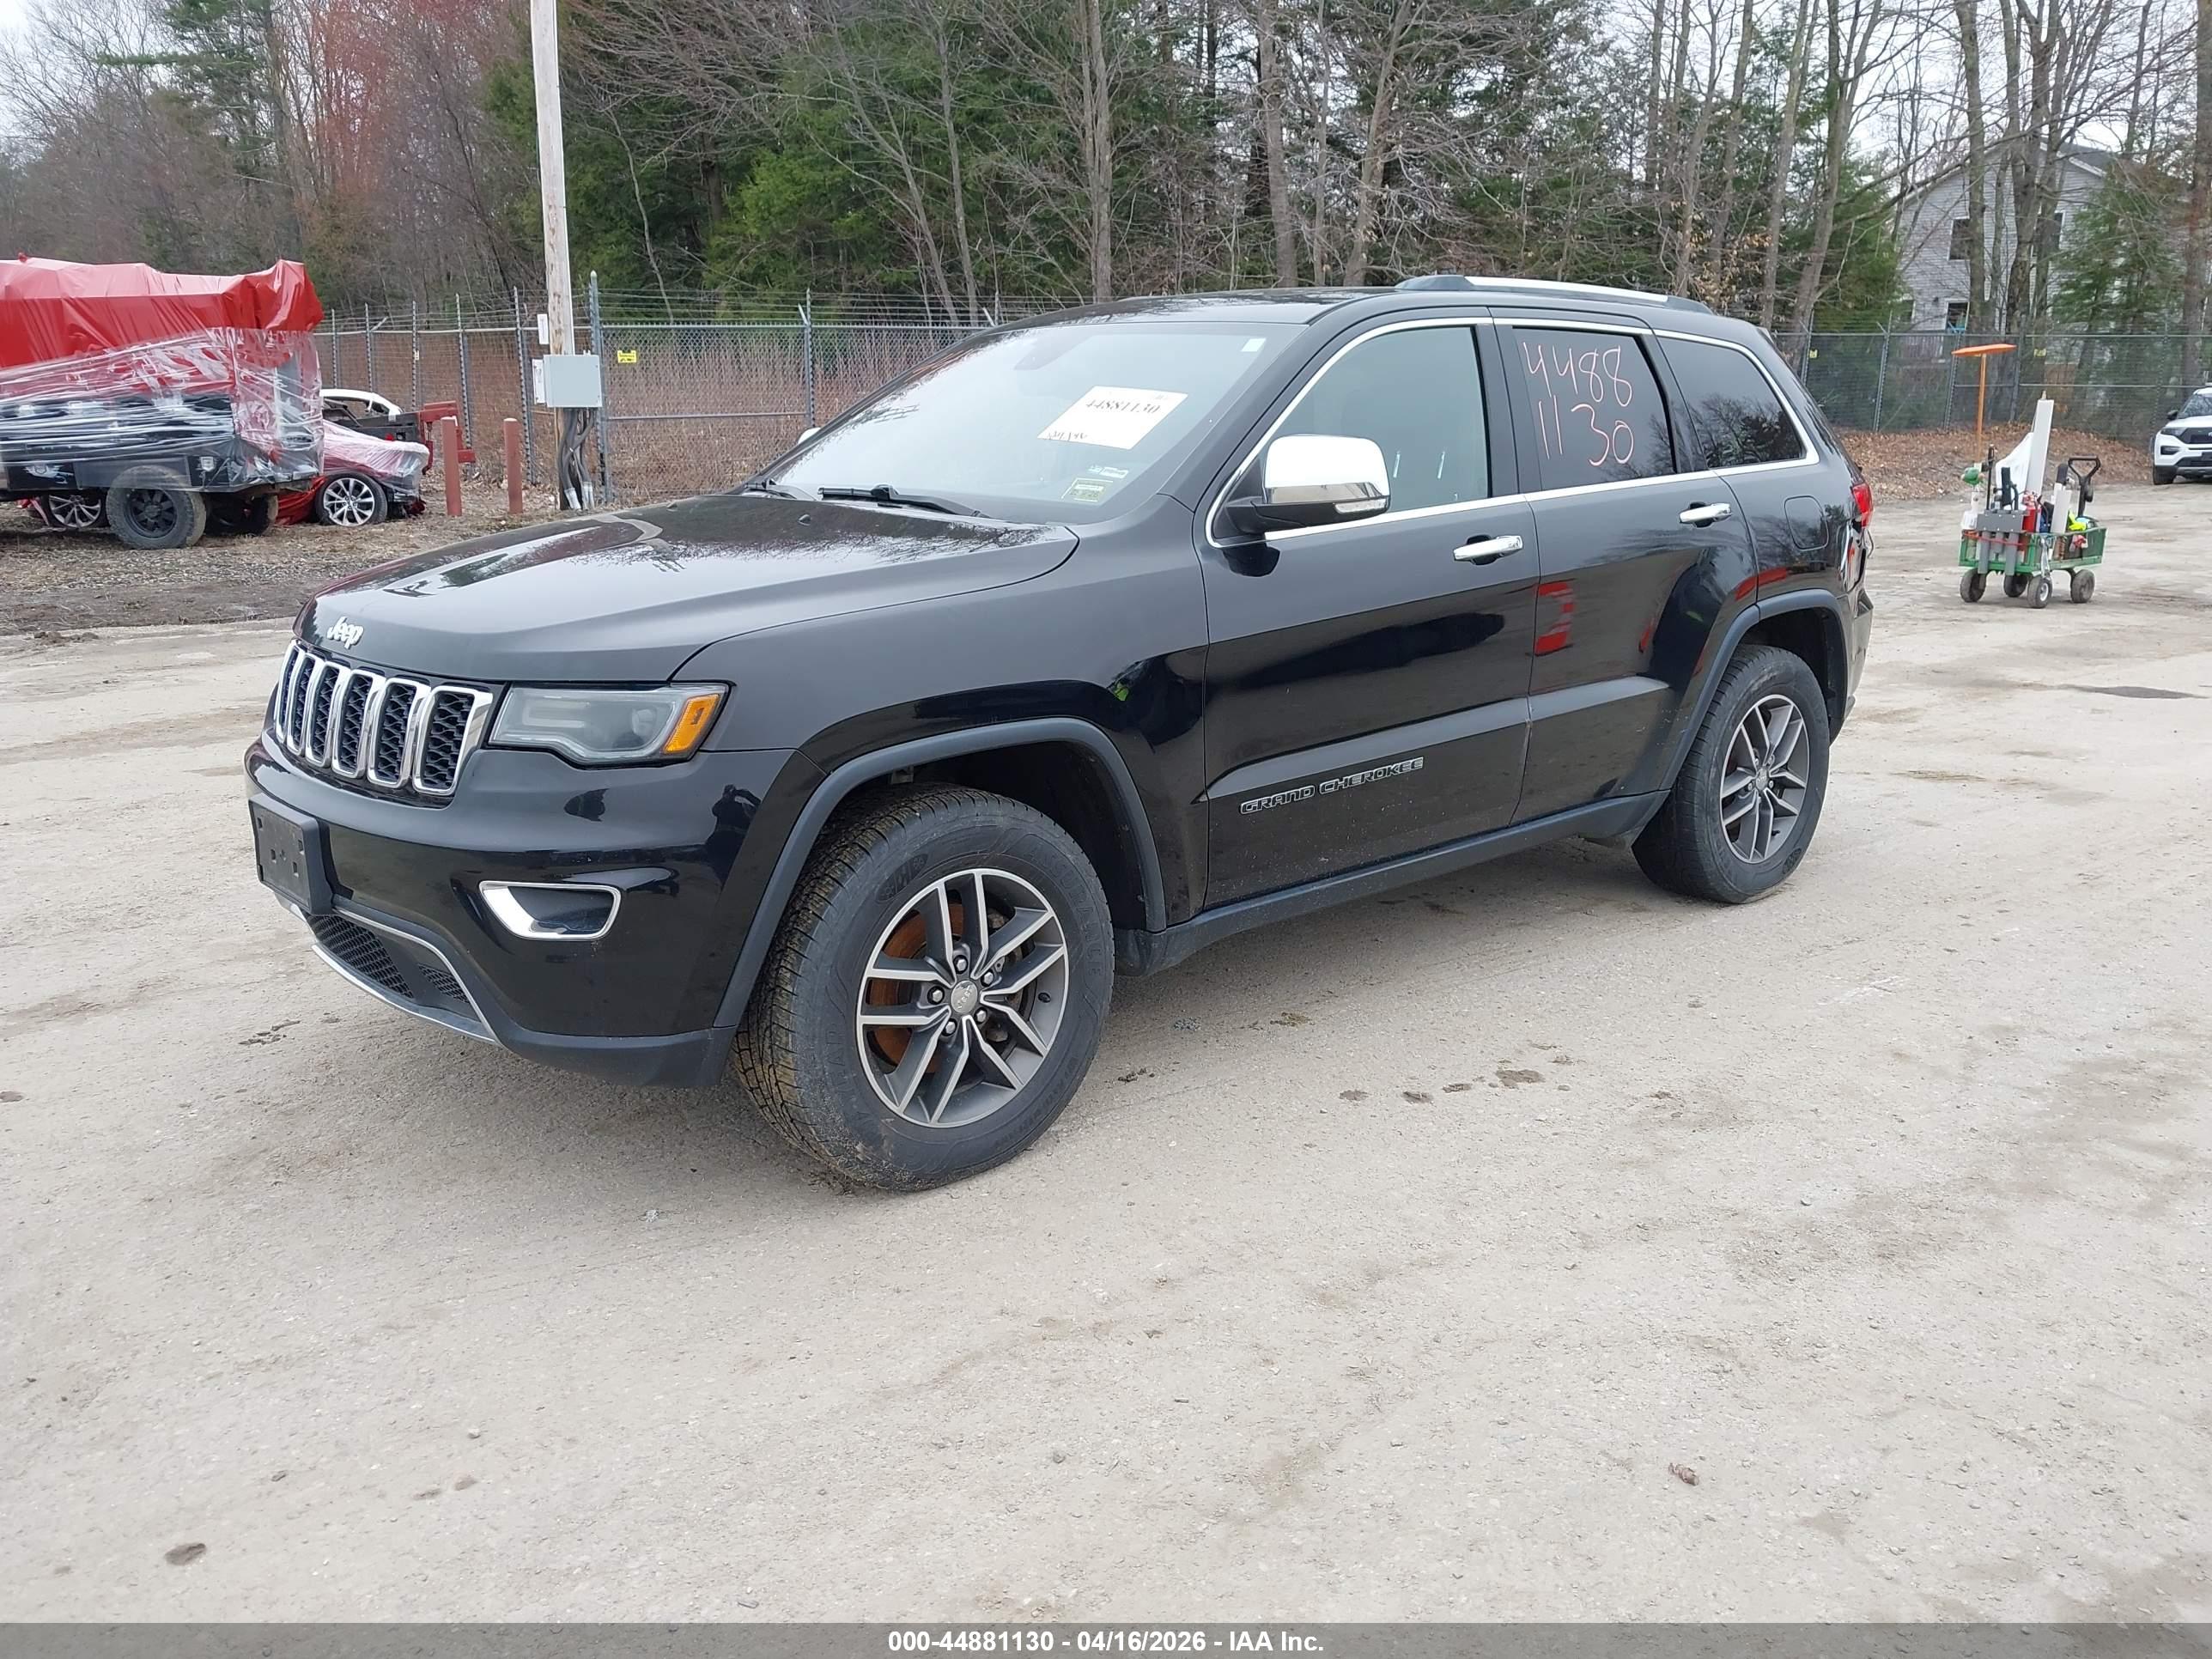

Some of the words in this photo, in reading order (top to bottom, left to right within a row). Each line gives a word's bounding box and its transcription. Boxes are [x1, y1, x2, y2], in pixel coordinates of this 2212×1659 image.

[1522, 342, 1632, 407] 4488
[326, 616, 364, 650] Jeep
[1239, 784, 1316, 815] GRAND
[1318, 756, 1425, 795] CHEROKEE
